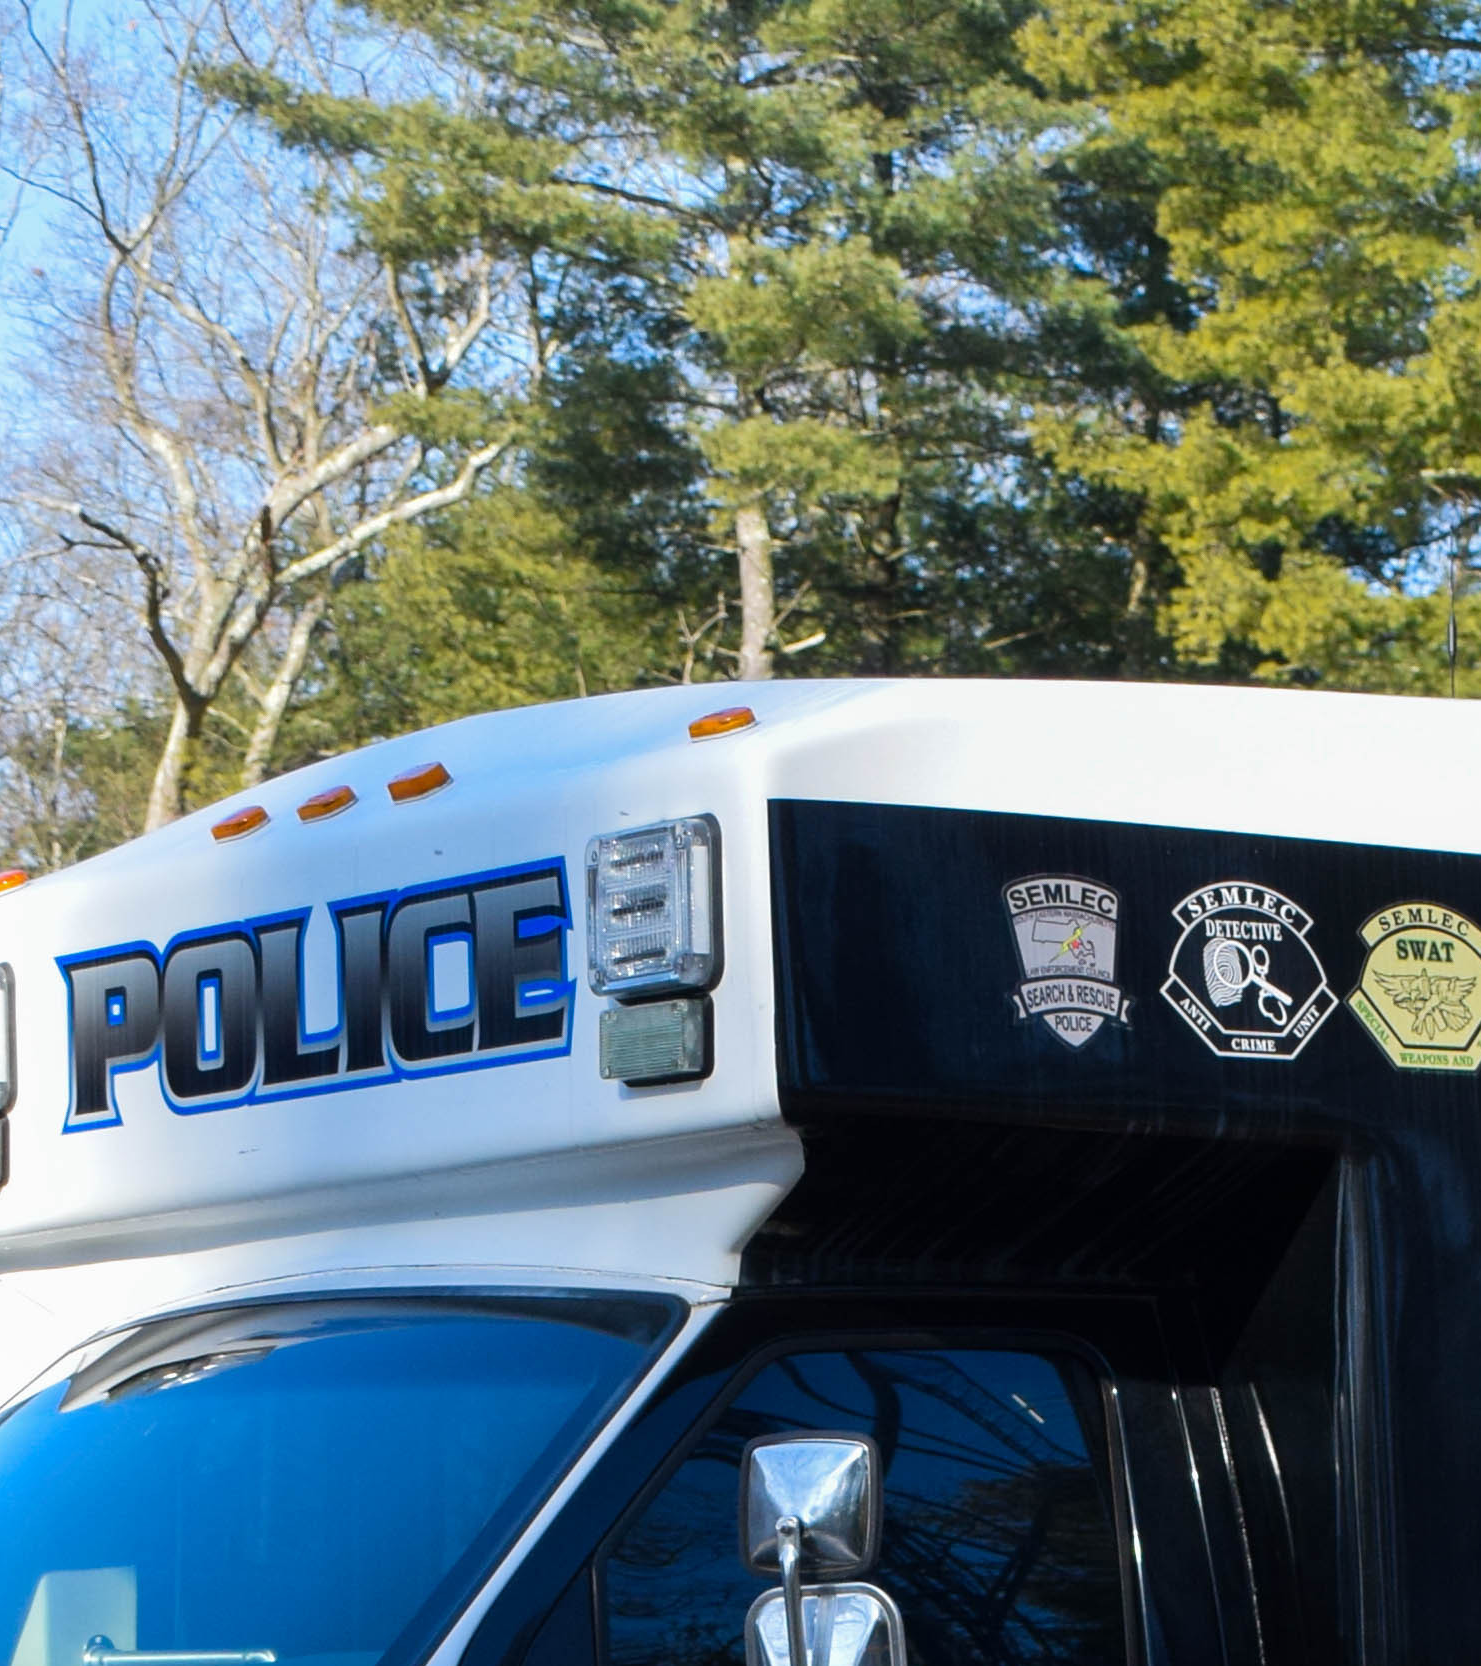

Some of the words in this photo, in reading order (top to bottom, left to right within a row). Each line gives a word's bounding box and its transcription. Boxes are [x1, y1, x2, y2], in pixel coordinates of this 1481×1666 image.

[1009, 883, 1115, 914] SEMLEC
[1187, 887, 1296, 923] SEMLEC
[1205, 919, 1282, 941] DETECTIVE
[1378, 908, 1469, 936] SEMLEC
[1396, 939, 1455, 962] SWAT
[55, 856, 576, 1134] POLICE
[1026, 984, 1065, 1009] SEARCH
[1068, 984, 1074, 1003] &
[1076, 985, 1116, 1012] RESCUE
[1055, 1015, 1093, 1033] POLICE
[1180, 997, 1211, 1032] ANTI
[1231, 1038, 1276, 1052] CRIME
[1293, 1005, 1320, 1039] UNIT
[1356, 999, 1390, 1046] SPECIAL
[1399, 1052, 1449, 1066] WEAPONS
[1452, 1055, 1474, 1067] AND
